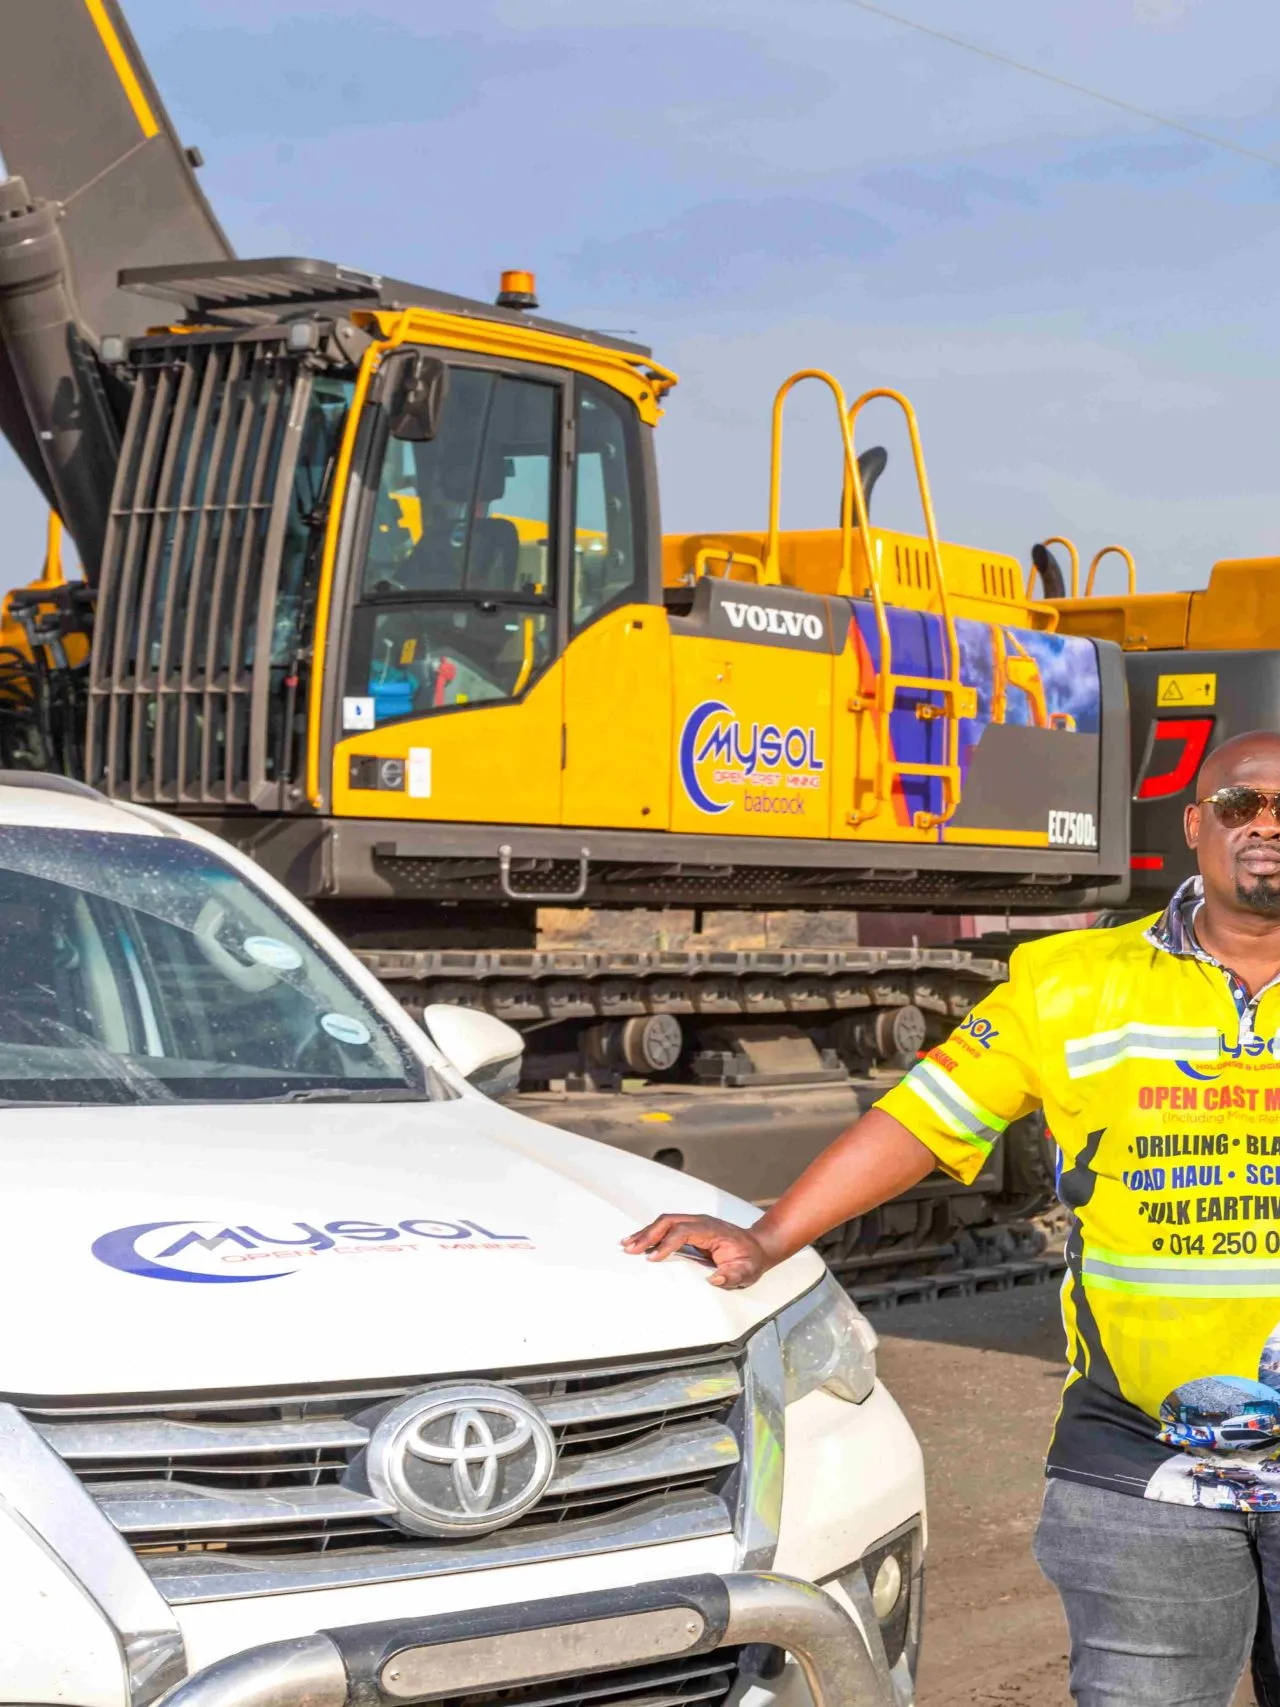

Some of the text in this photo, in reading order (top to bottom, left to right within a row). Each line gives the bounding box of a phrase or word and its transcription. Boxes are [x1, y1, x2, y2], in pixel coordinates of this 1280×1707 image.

[720, 600, 824, 640] VOLVO
[744, 788, 805, 815] babcock
[1138, 1086, 1197, 1110] OPEN
[1203, 1085, 1259, 1111] CAST
[1136, 1134, 1228, 1159] DRILLING
[1171, 1165, 1223, 1189] HAUL
[153, 1218, 530, 1258] MYSOL
[1170, 1233, 1205, 1255] 014
[1212, 1230, 1257, 1255] 250
[220, 1240, 537, 1264] OPEN CAST MINING
